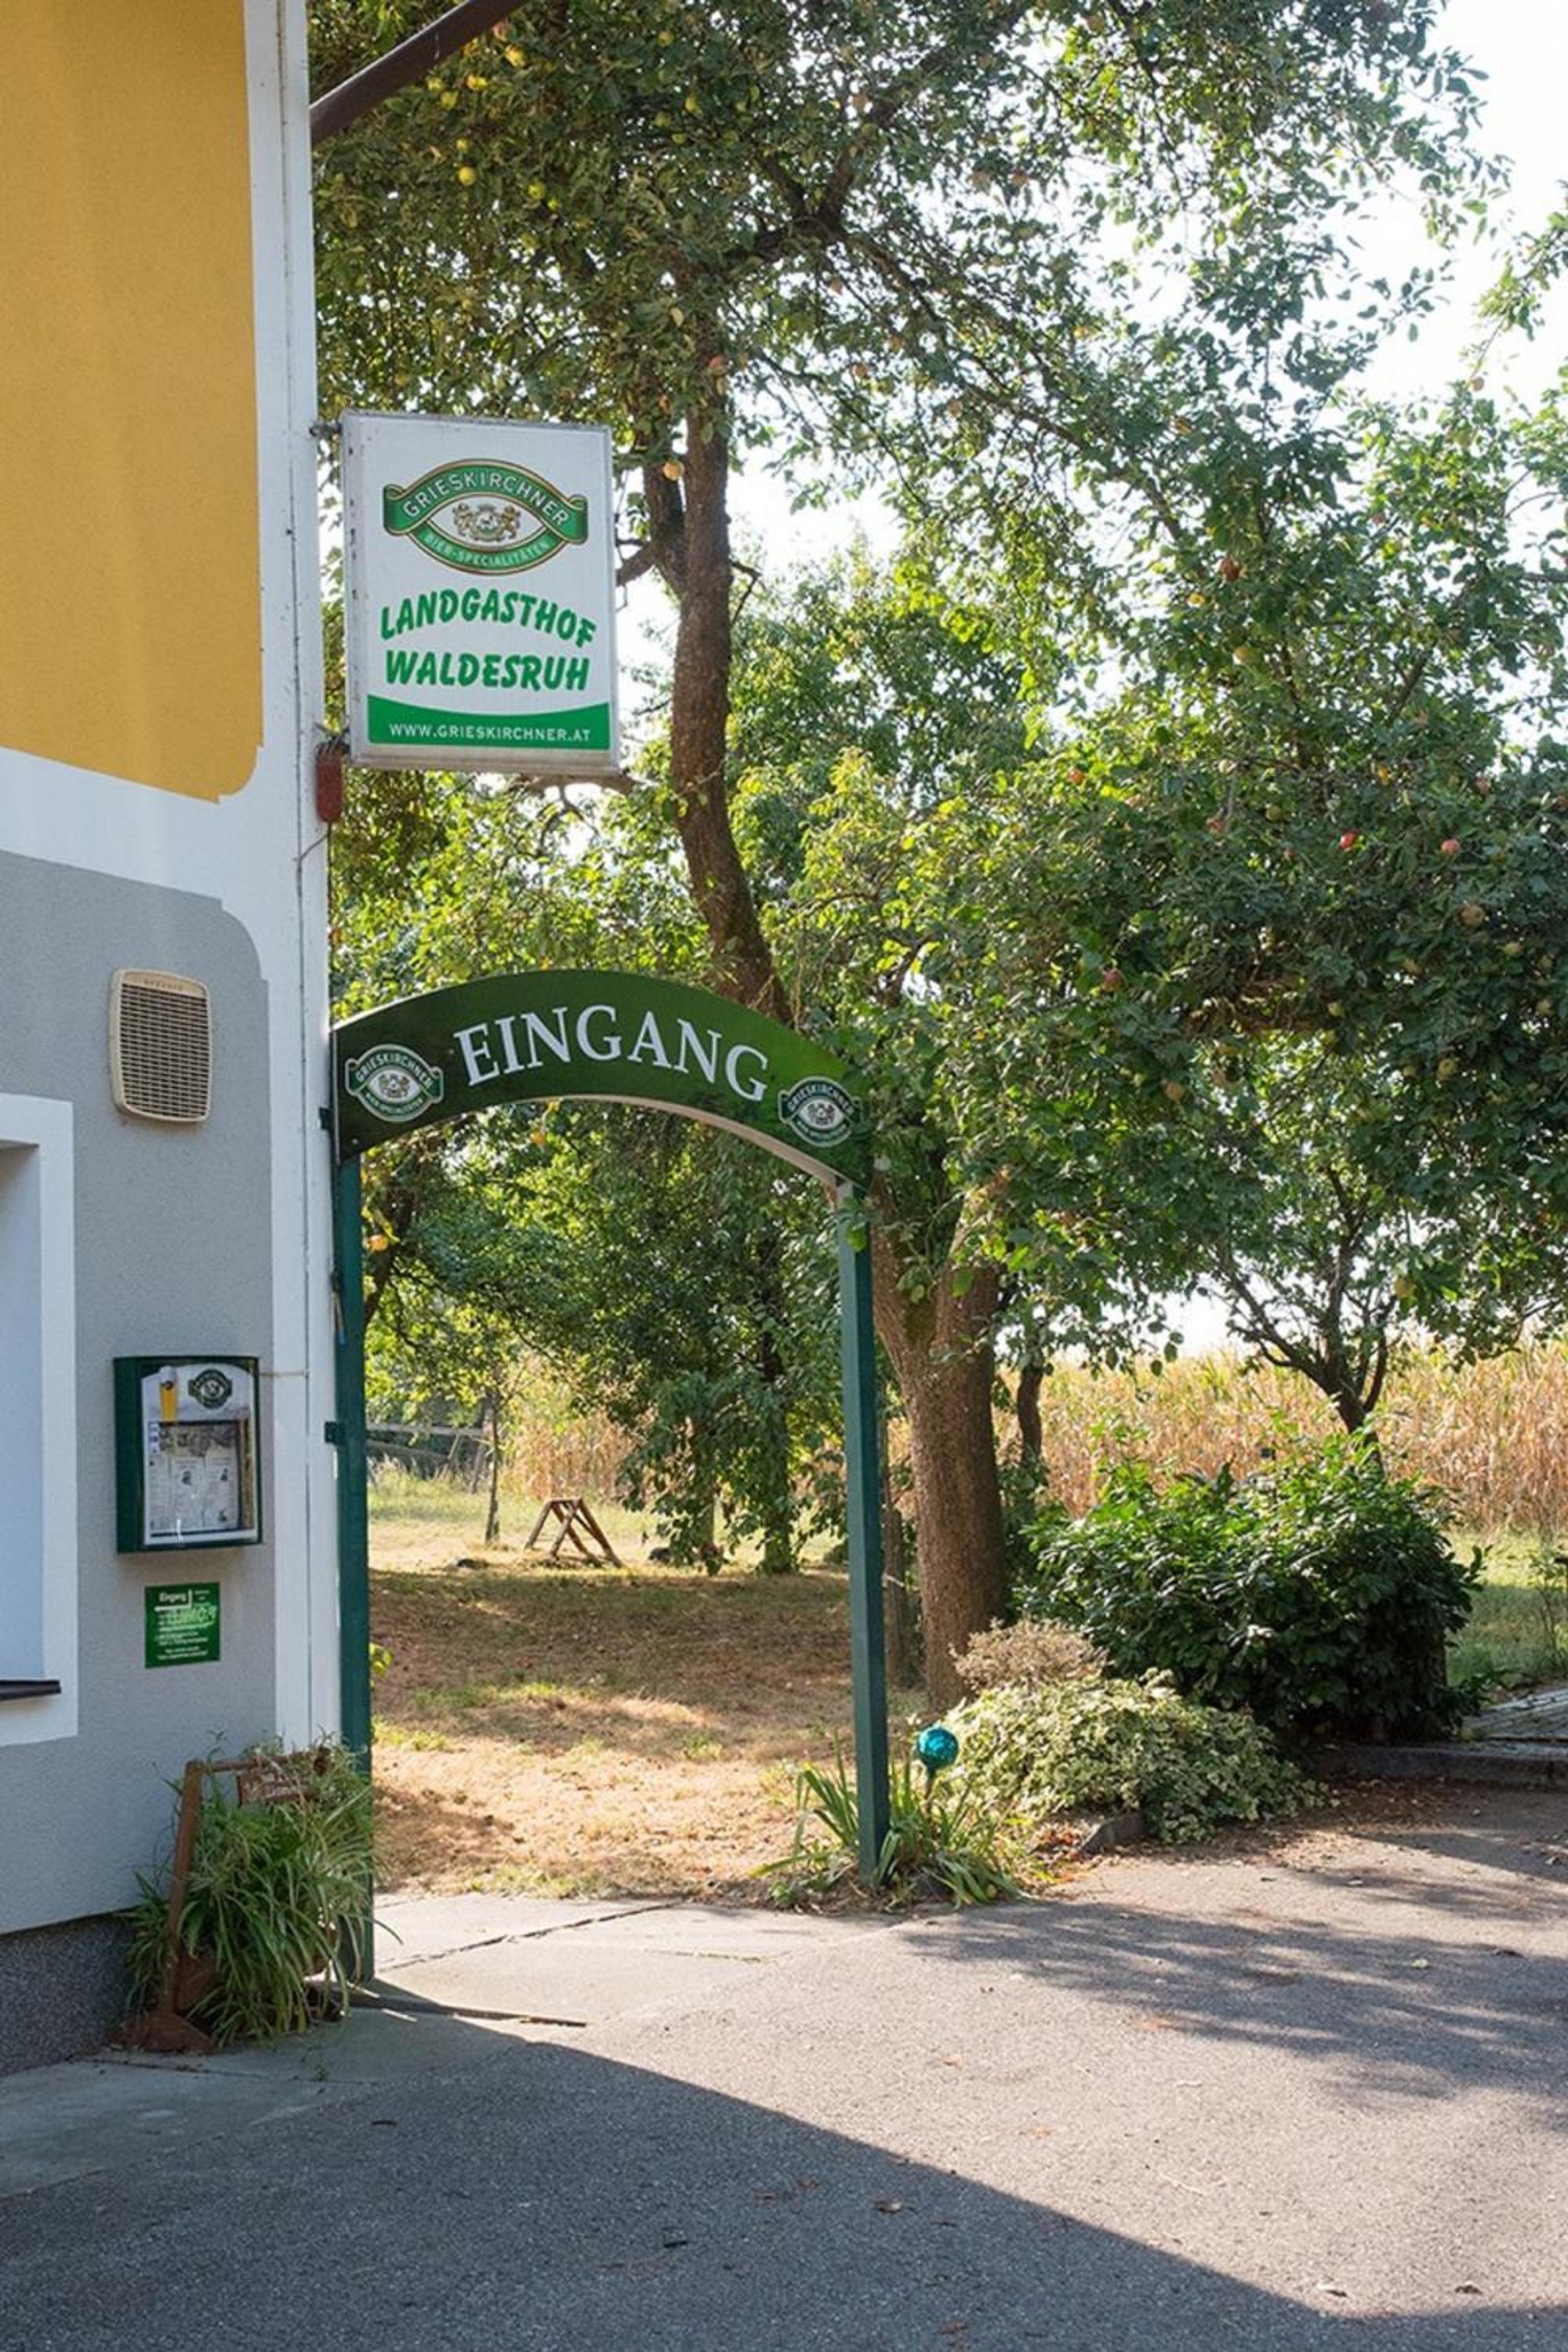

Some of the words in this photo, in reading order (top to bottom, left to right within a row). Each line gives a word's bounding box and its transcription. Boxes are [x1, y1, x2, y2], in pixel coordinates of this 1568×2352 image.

[403, 471, 570, 526] GRIESKIRCHNER
[381, 589, 597, 648] LANDGASTHOF
[386, 650, 590, 691] WALDESRUH
[389, 722, 590, 742] WWW.GRIESKIRCHNER.AT
[454, 1004, 768, 1102] EINGANG
